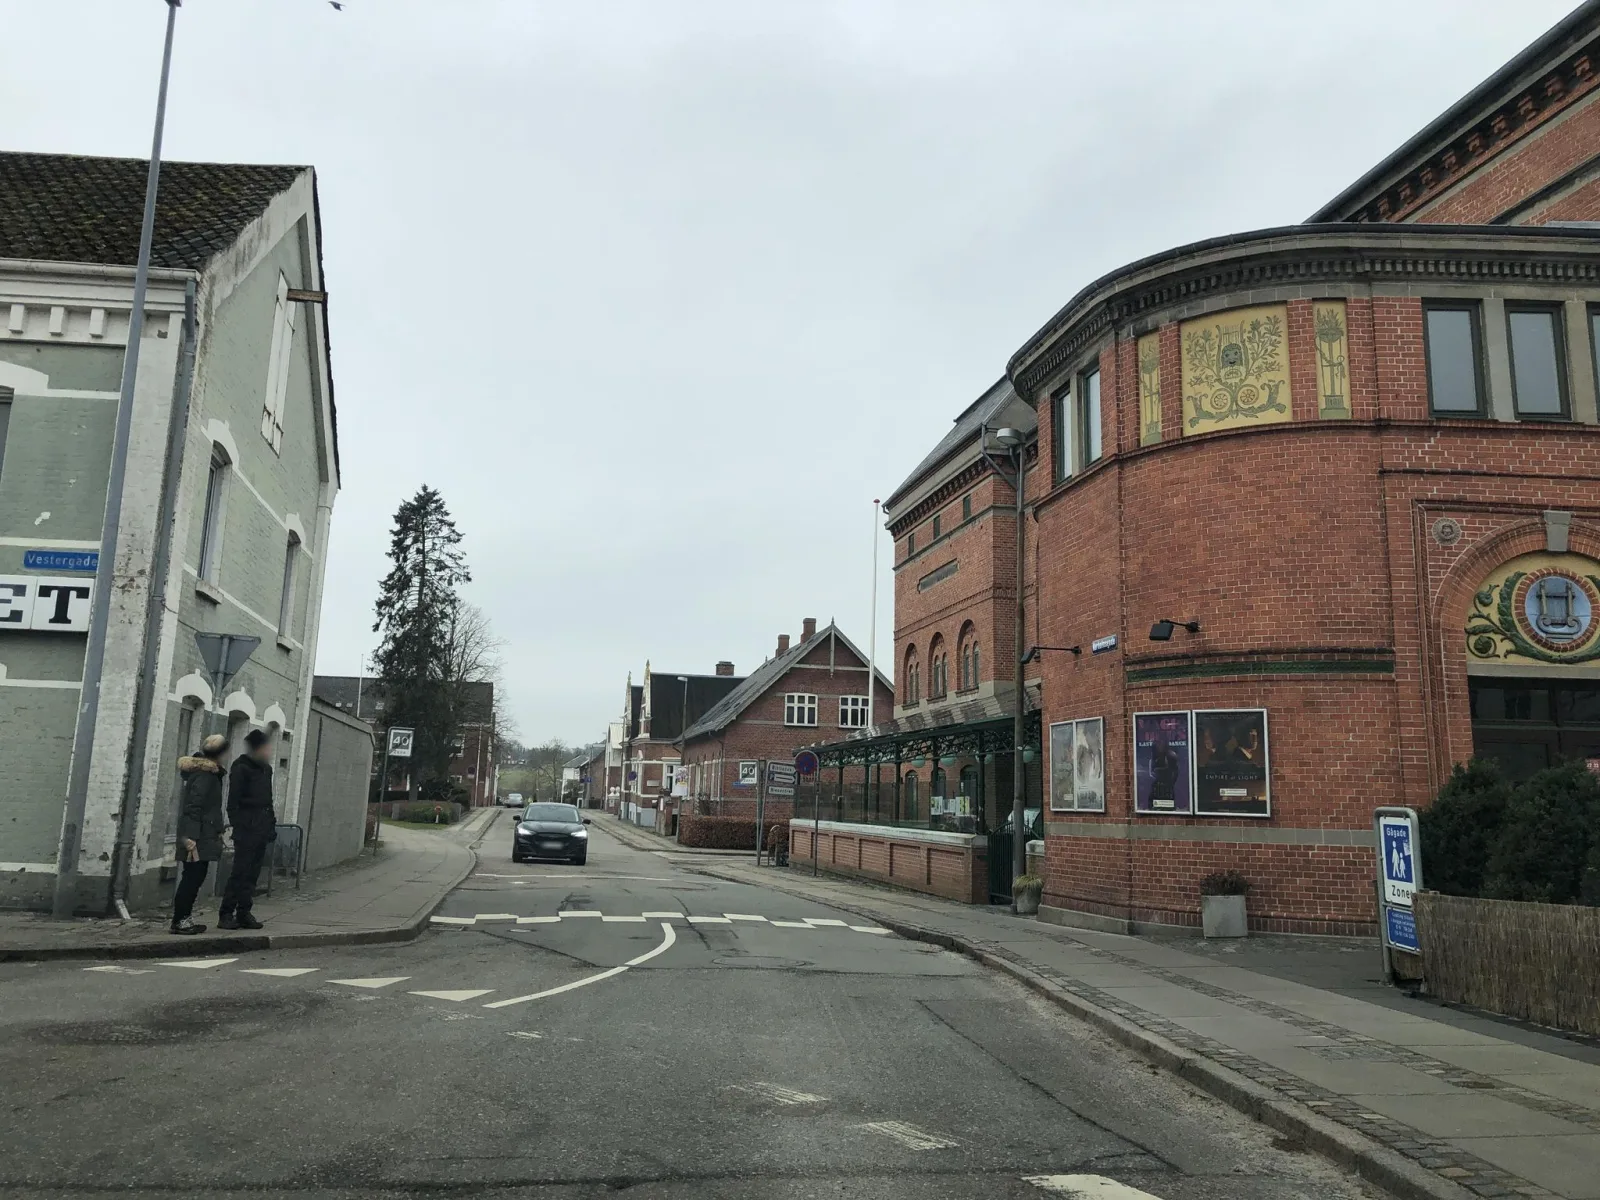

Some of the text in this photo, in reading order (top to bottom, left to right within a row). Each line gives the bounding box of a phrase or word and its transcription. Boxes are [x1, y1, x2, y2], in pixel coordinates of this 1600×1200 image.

[27, 553, 98, 569] Vestergade
[392, 736, 409, 746] 40
[742, 767, 755, 775] 40
[1386, 827, 1407, 838] Gågade
[1391, 884, 1411, 899] Zone
